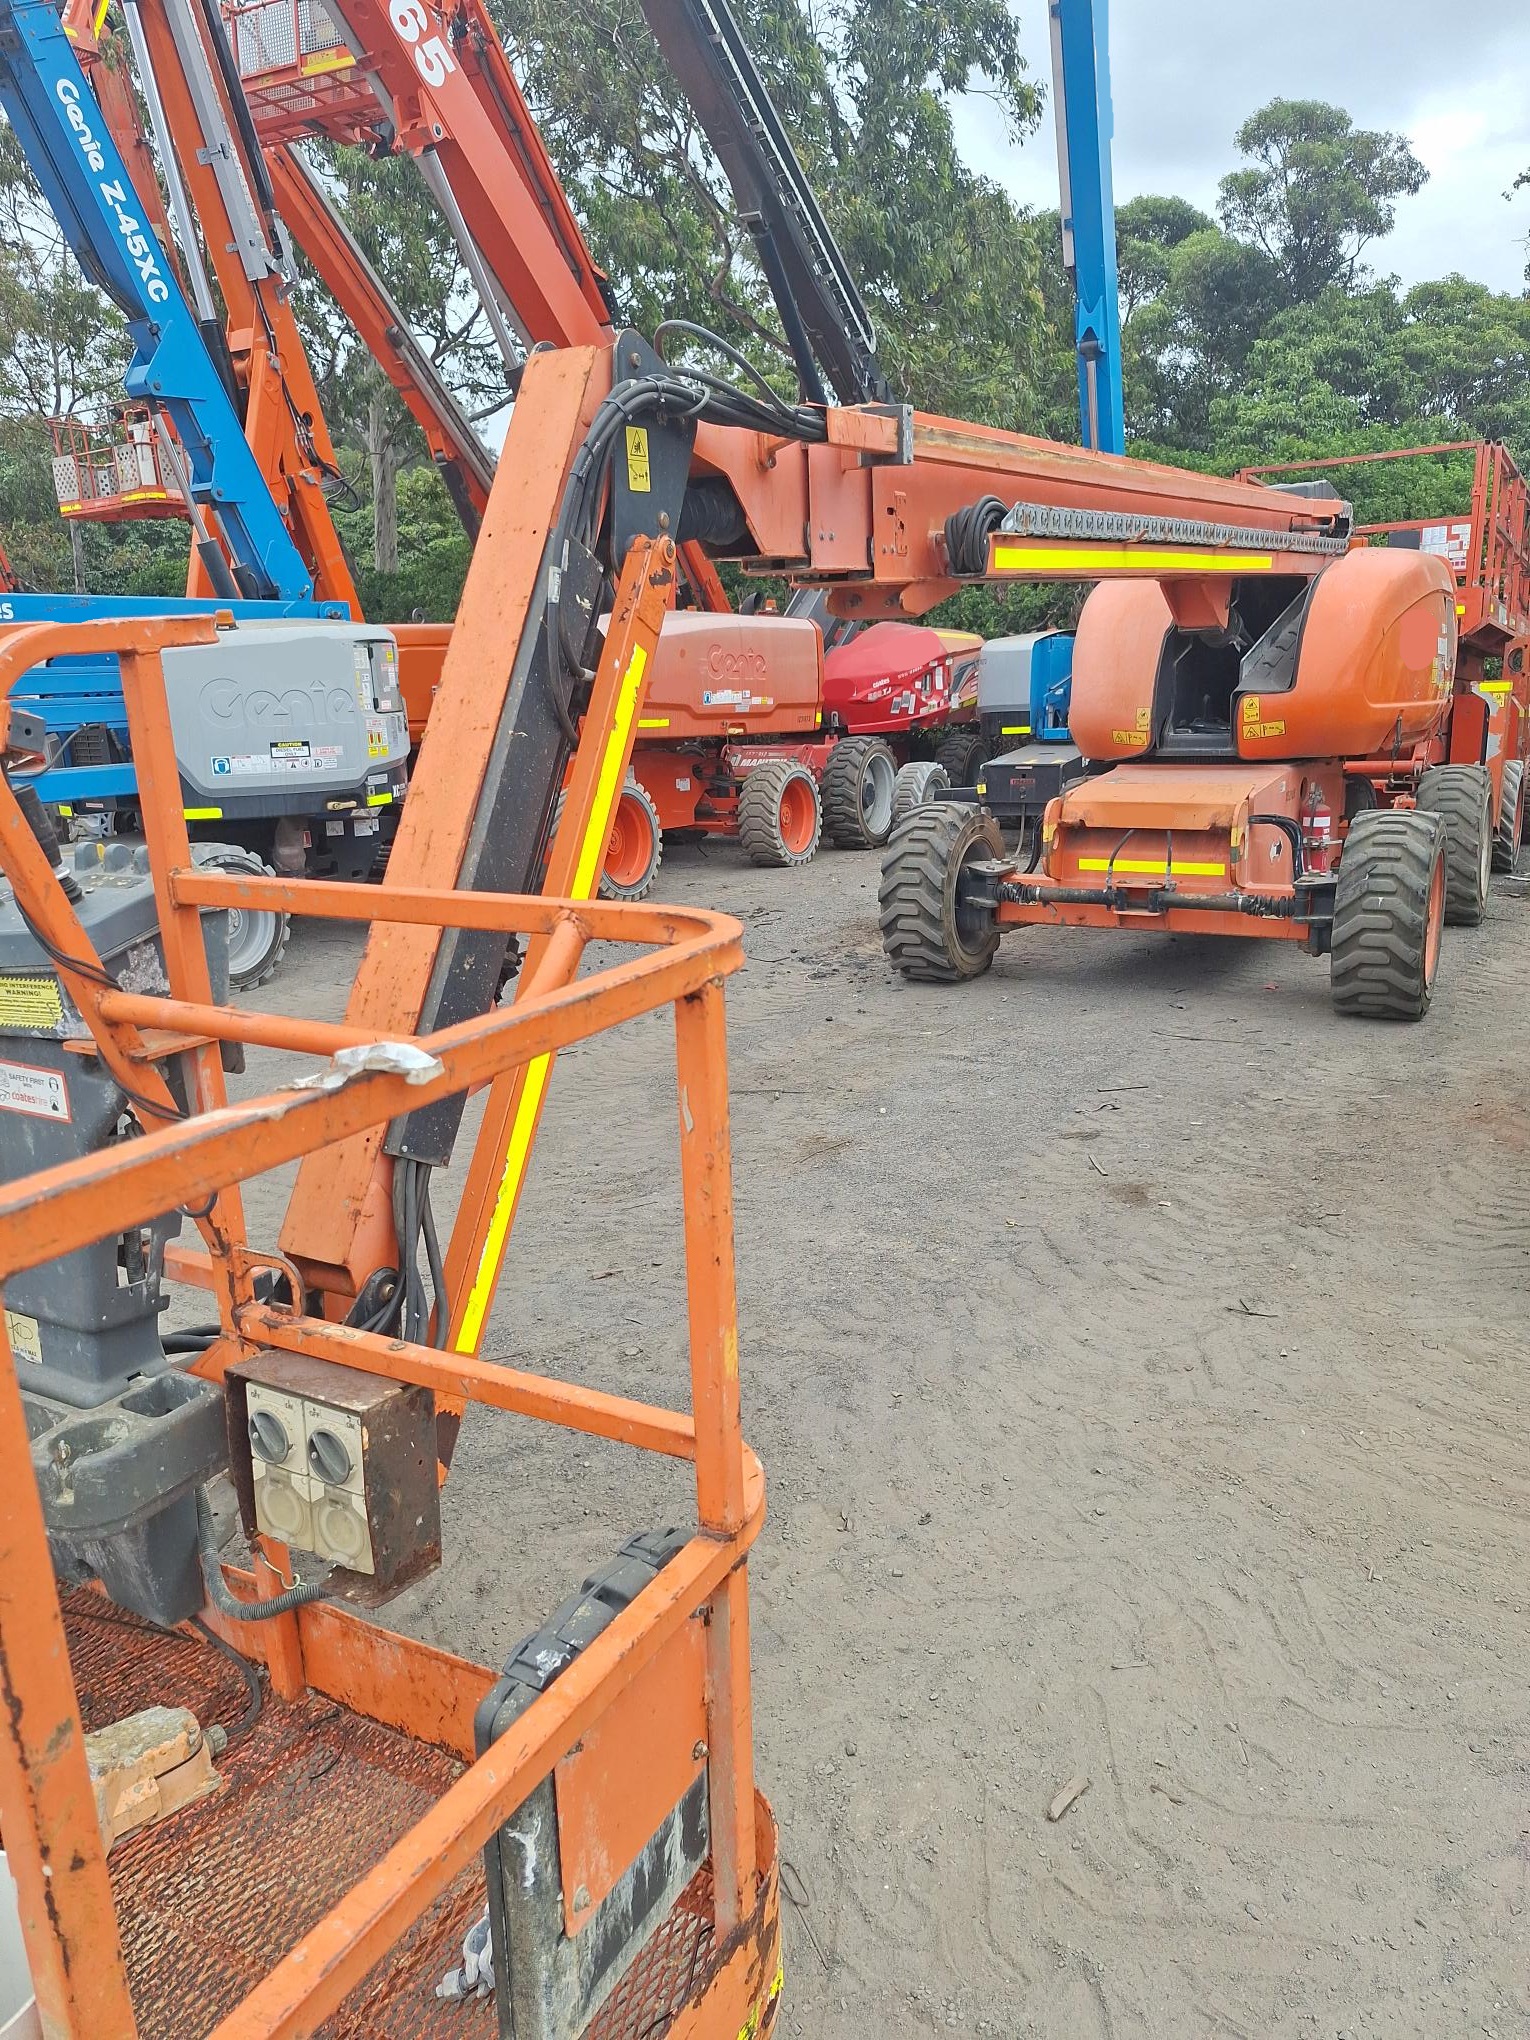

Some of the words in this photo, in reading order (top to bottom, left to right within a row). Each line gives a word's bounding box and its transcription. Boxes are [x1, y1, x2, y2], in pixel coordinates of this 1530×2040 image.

[388, 0, 457, 88] 65
[56, 78, 105, 173] Genie
[100, 179, 169, 303] Z-45XC
[0, 602, 14, 620] s
[707, 643, 767, 681] Genie
[199, 677, 354, 729] Genie
[9, 1073, 28, 1083] SAFETY
[29, 1077, 44, 1086] FIRST
